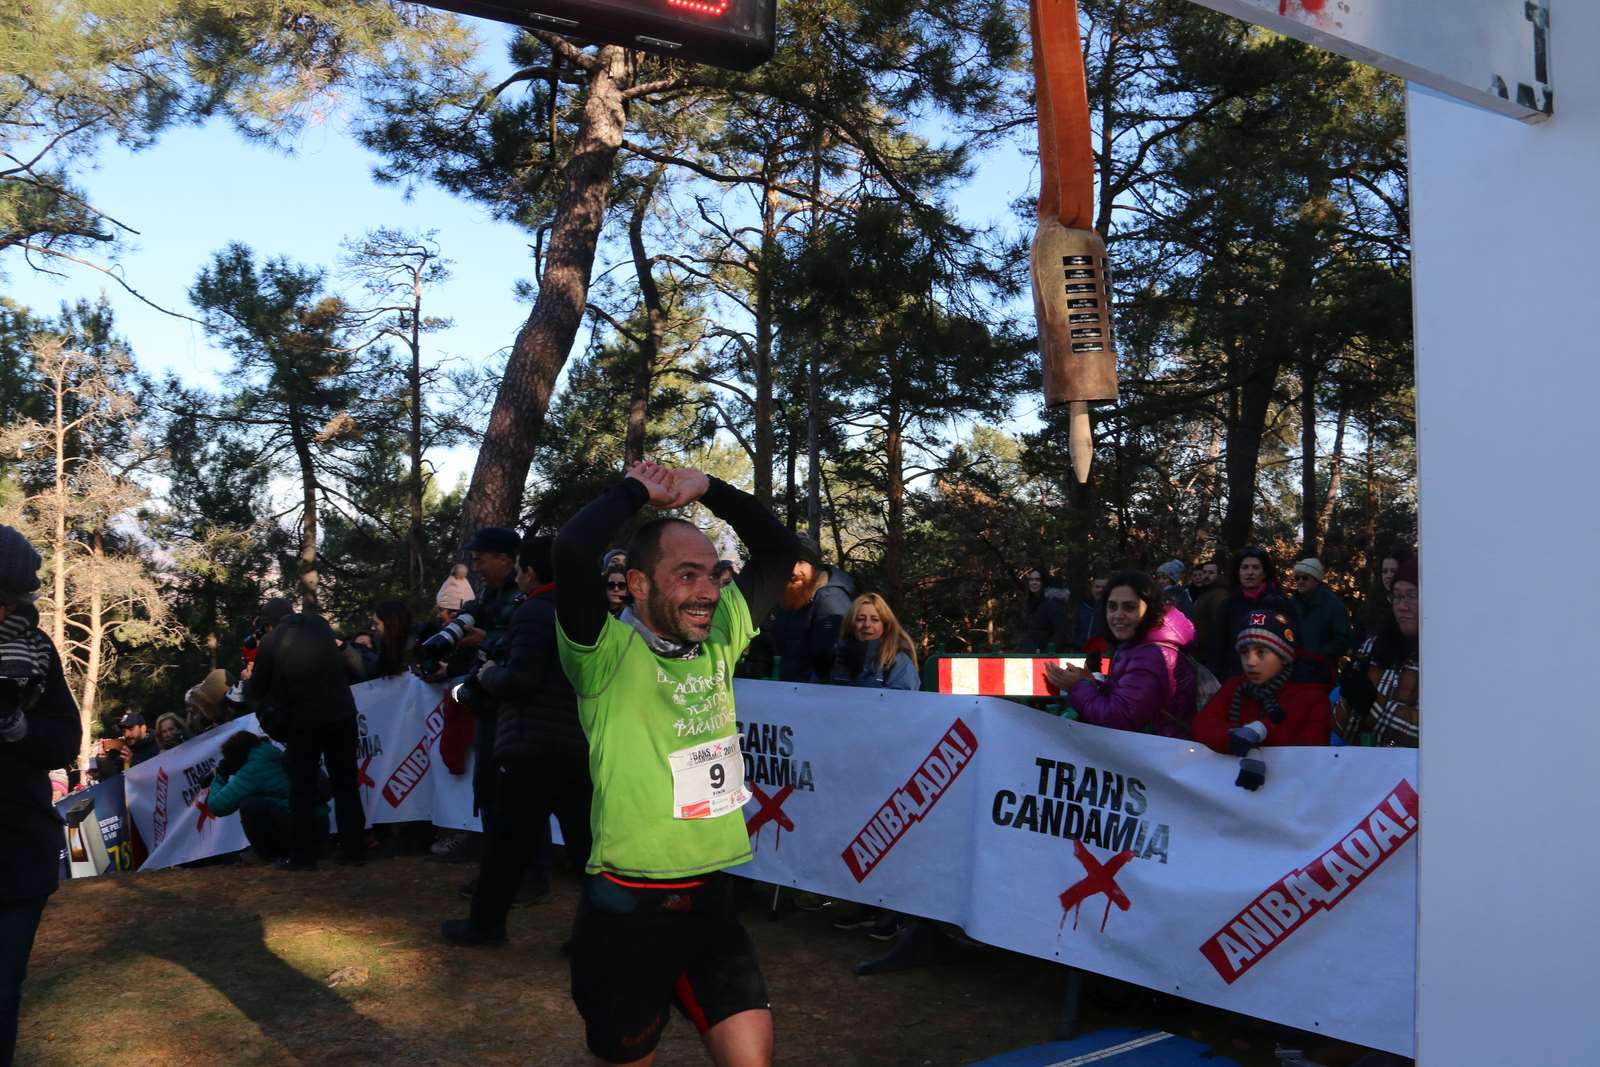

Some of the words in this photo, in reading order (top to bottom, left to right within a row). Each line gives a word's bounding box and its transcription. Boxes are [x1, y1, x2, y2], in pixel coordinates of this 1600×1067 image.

[736, 720, 795, 757] RANS
[709, 763, 725, 789] 9
[742, 752, 815, 792] DAMIA
[850, 728, 973, 874] ANIBALADA!
[1035, 757, 1148, 816] TRANS
[992, 789, 1170, 864] CANDAMIA
[1216, 792, 1417, 973] ANIBALADA!
